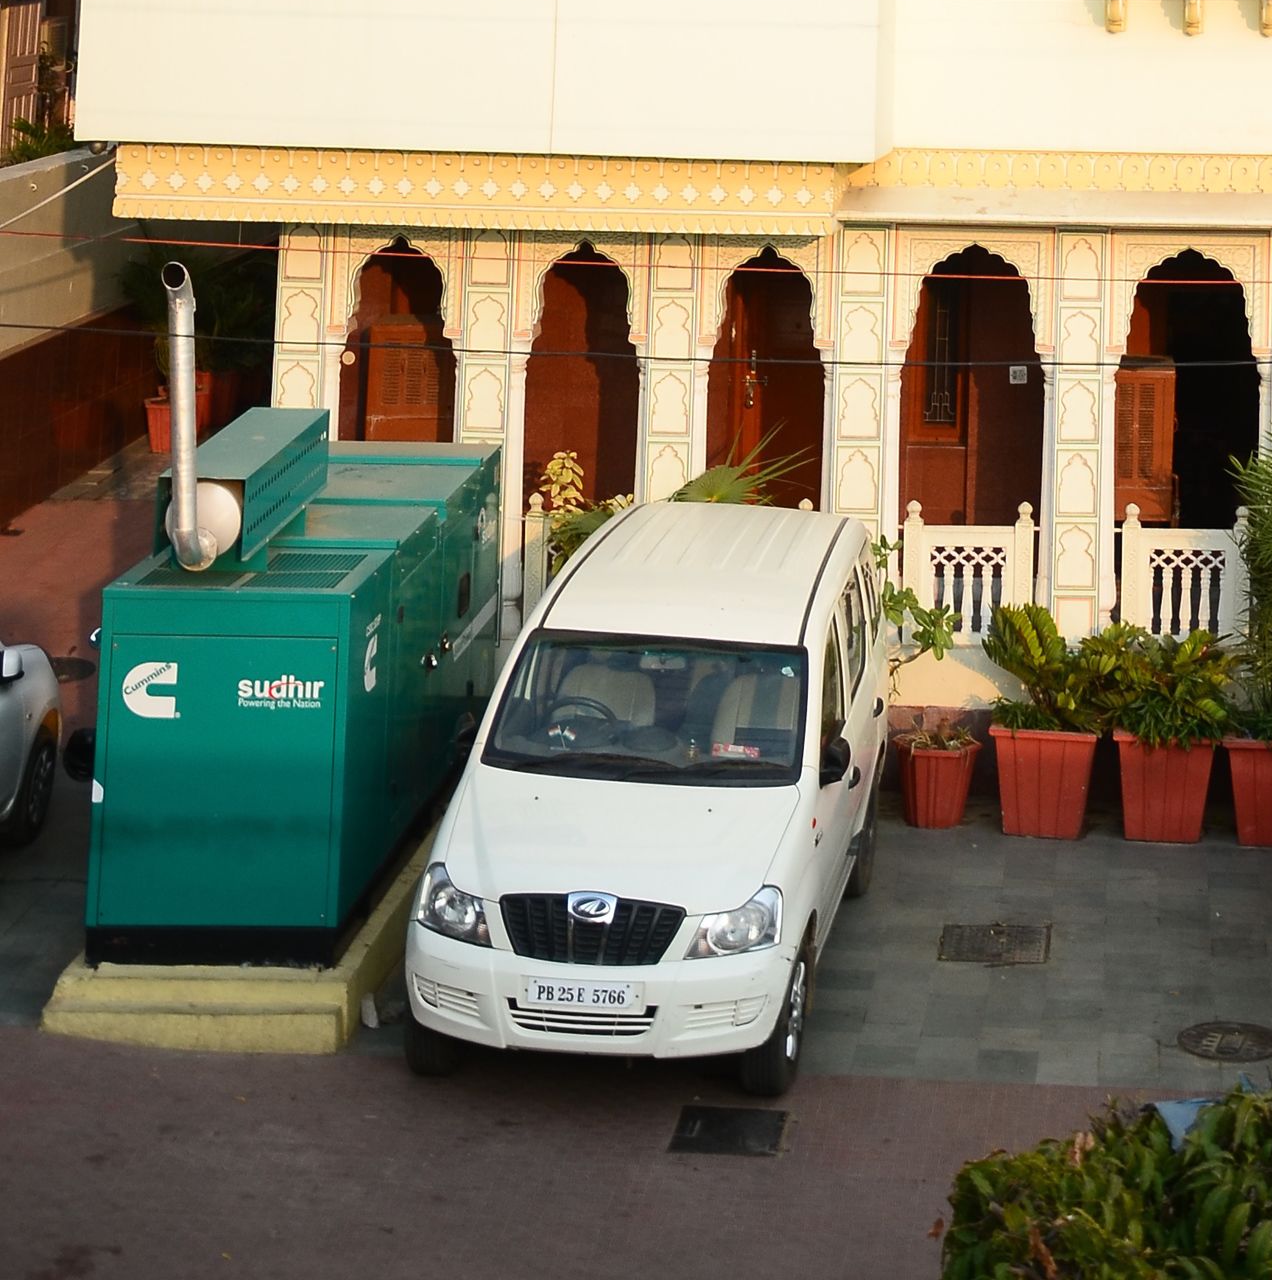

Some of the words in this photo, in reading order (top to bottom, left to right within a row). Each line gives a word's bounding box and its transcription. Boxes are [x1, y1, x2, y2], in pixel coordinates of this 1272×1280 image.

[123, 662, 173, 696] Cummins
[237, 674, 325, 700] sudhir
[238, 698, 276, 710] Powering
[277, 698, 291, 709] the
[292, 699, 321, 709] Nation
[537, 985, 554, 1001] PB
[557, 986, 575, 1002] 25
[577, 987, 586, 1003] E
[591, 989, 626, 1005] 5766
